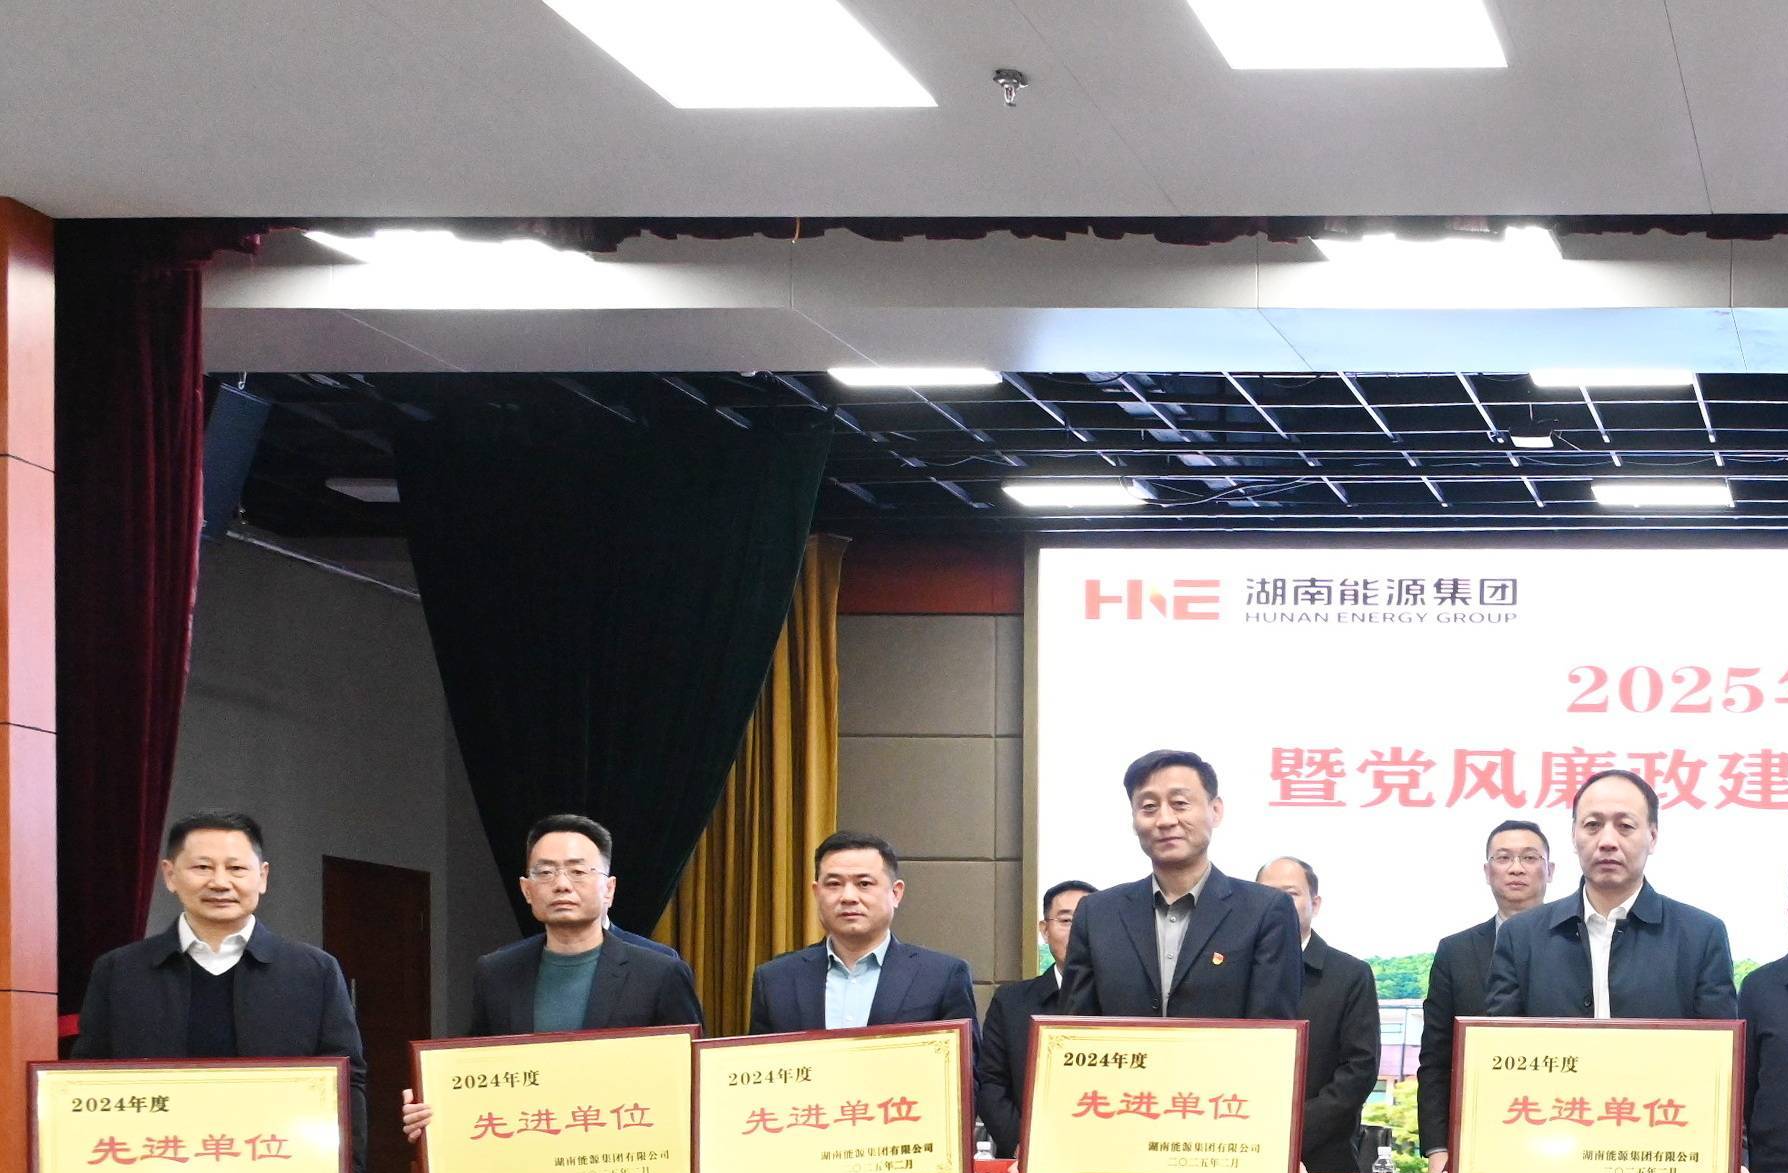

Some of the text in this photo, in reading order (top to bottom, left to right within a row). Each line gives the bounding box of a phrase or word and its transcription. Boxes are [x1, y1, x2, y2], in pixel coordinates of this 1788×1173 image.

[1246, 577, 1518, 606] 湖南能源集团
[1246, 612, 1517, 623] HUNAN ENERGY GROUP
[1063, 1051, 1149, 1070] 2024年度
[1491, 1054, 1579, 1074] 2024年度
[452, 1069, 541, 1091] 2024年度
[728, 1065, 813, 1087] 2024年度
[72, 1094, 171, 1114] 2024年度
[1072, 1090, 1250, 1120] 先进单位
[1502, 1096, 1688, 1128] 先进单位
[470, 1103, 654, 1141] 先进单位
[743, 1096, 921, 1135] 先进单位
[87, 1133, 291, 1166] 先进单位
[554, 1149, 670, 1167] 湖南能源集团有限公司
[820, 1142, 934, 1161] 湖南能源集团有限公司
[1147, 1140, 1261, 1155] 湖南能源集团有限公司
[1582, 1149, 1700, 1164] 湖南能源集团有限公司
